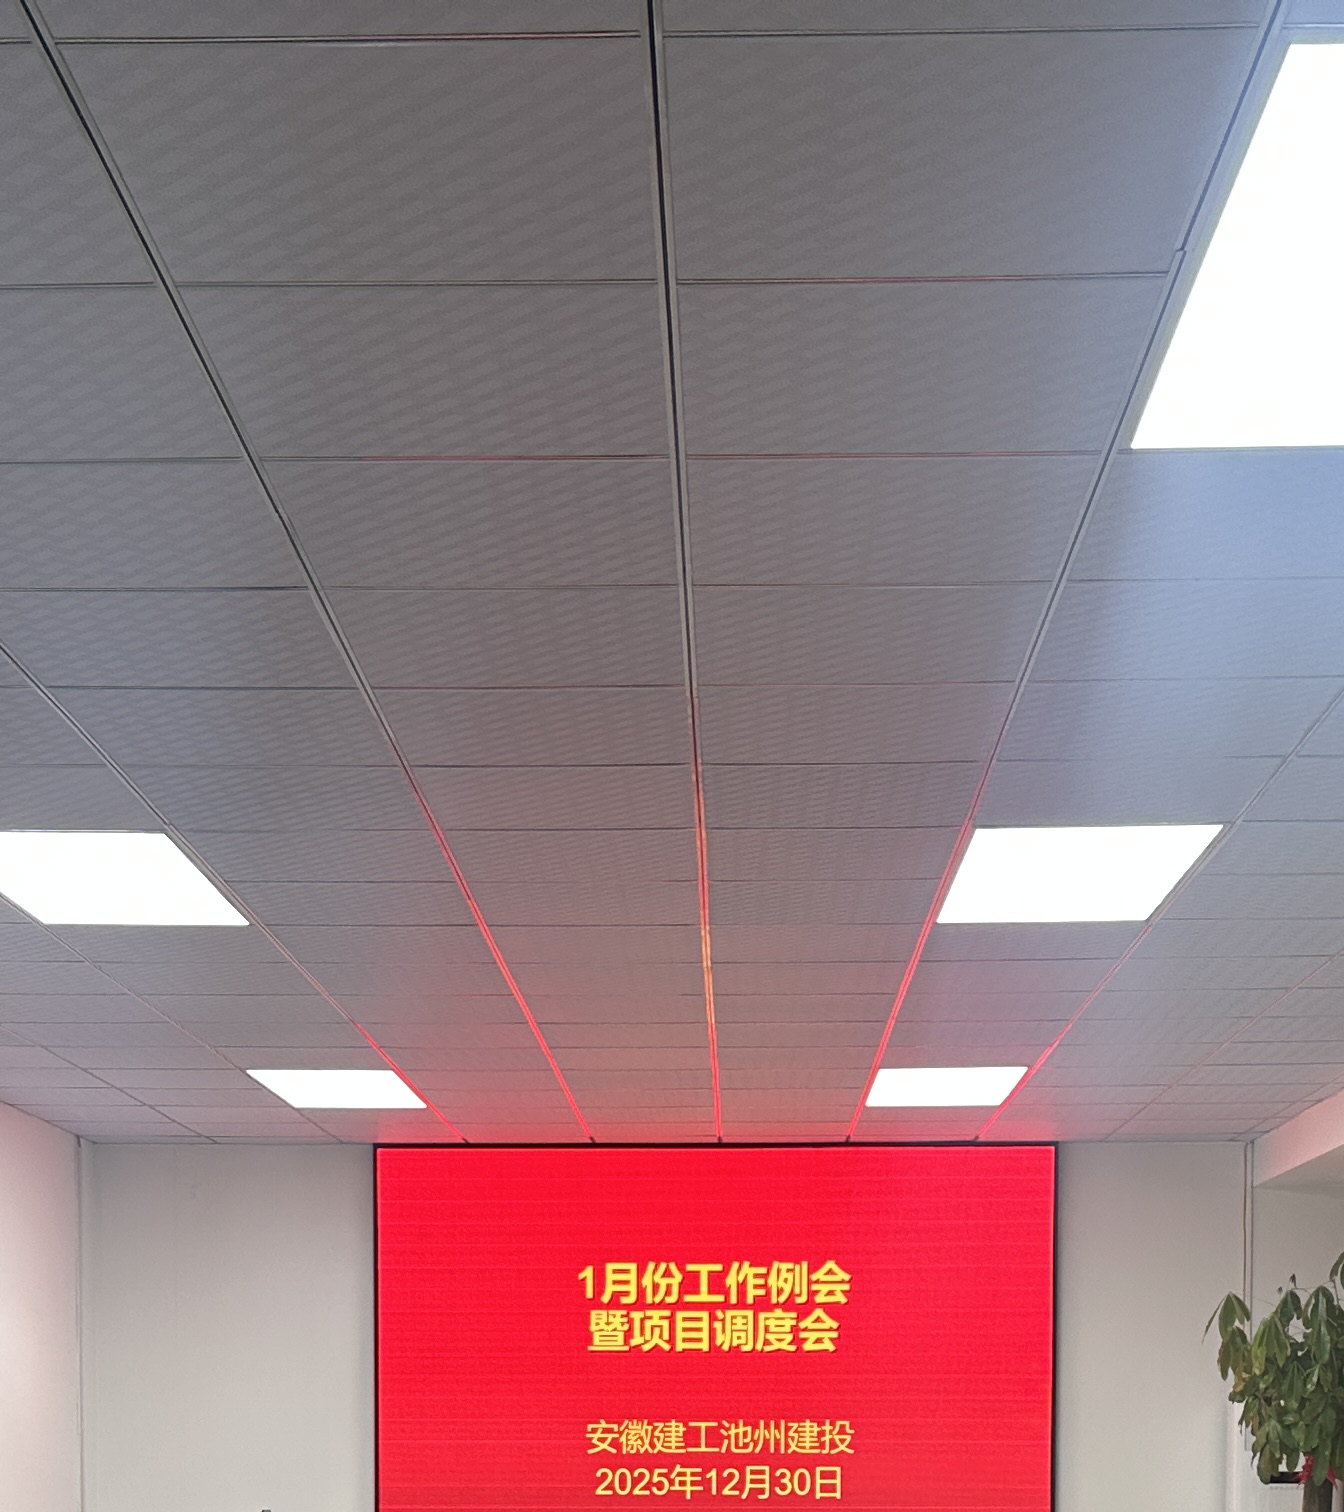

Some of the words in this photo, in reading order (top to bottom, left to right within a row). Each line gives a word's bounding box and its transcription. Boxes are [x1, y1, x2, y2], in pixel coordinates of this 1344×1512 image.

[577, 1260, 852, 1305] 1月份工作例会
[587, 1309, 840, 1353] 暨项目调度会
[585, 1419, 856, 1456] 安徽建工池州建投
[595, 1465, 843, 1501] 2025年12月30日
